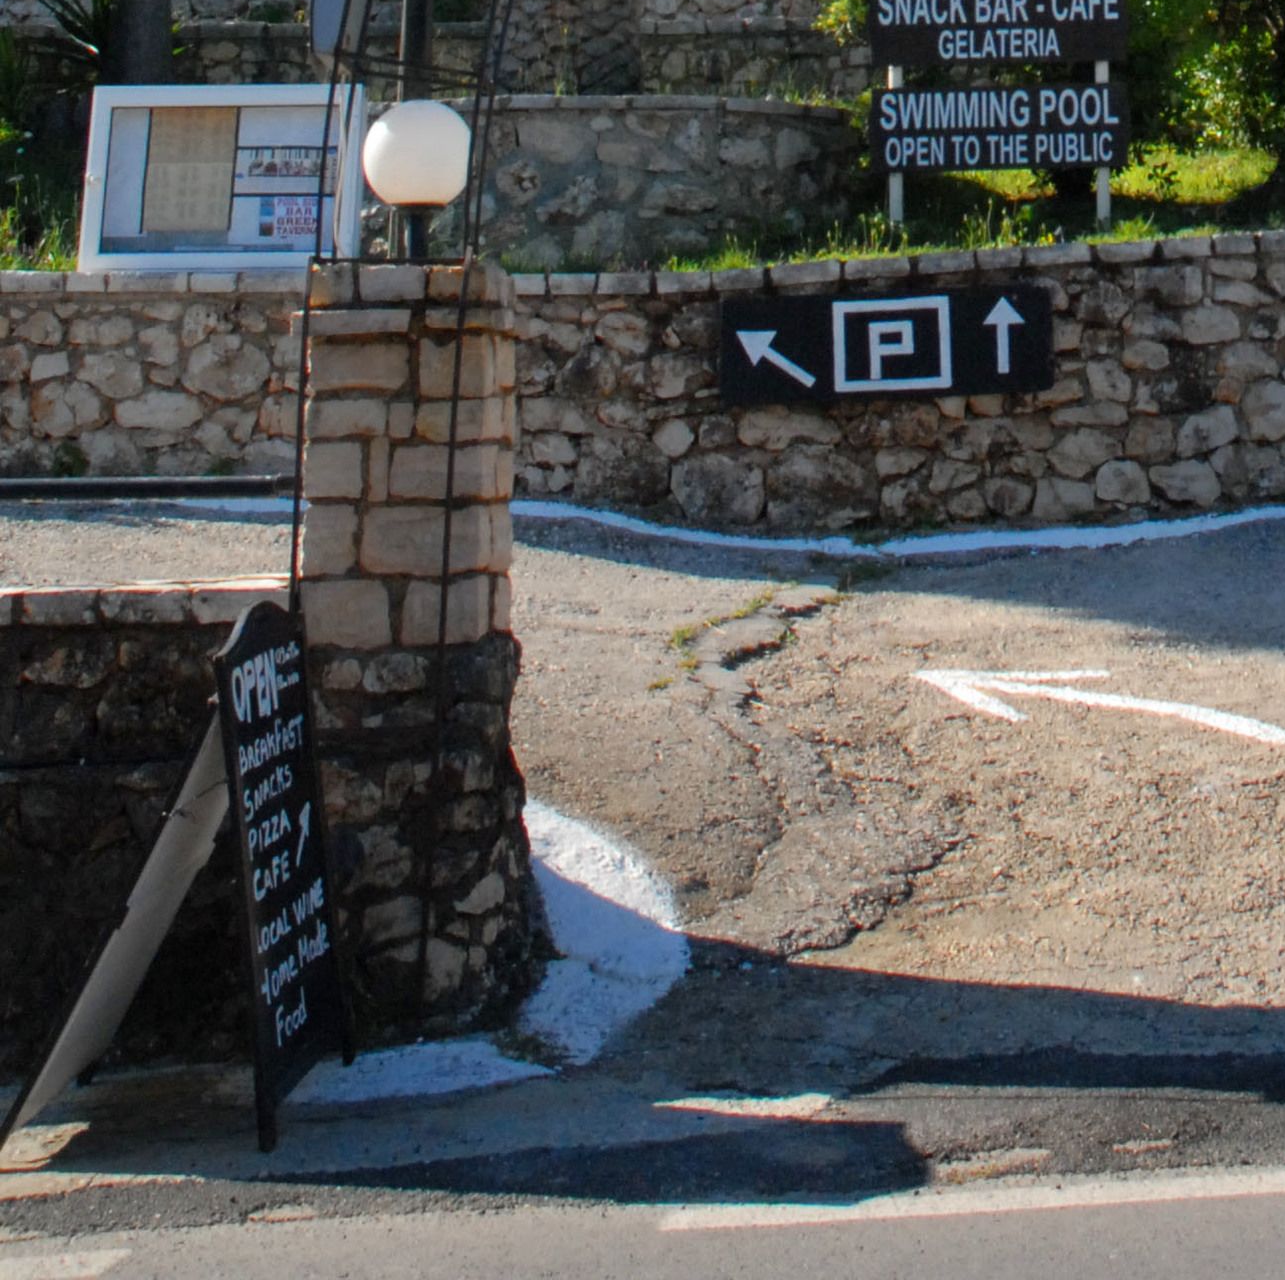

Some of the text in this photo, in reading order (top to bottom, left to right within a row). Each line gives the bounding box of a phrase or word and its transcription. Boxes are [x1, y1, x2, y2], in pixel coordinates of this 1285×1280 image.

[938, 28, 1060, 60] GELATERIA
[879, 88, 1119, 130] SWIMMING POOL
[885, 132, 1113, 166] OPEN TO THE PUBLIC
[286, 207, 312, 217] BAR
[869, 320, 914, 380] P
[231, 647, 278, 724] OPEN
[238, 713, 304, 777] BREAKFAST
[244, 764, 292, 822] SNACKS
[248, 808, 291, 861] PIZZA
[253, 849, 290, 901] CAFE
[275, 987, 307, 1047] Food
